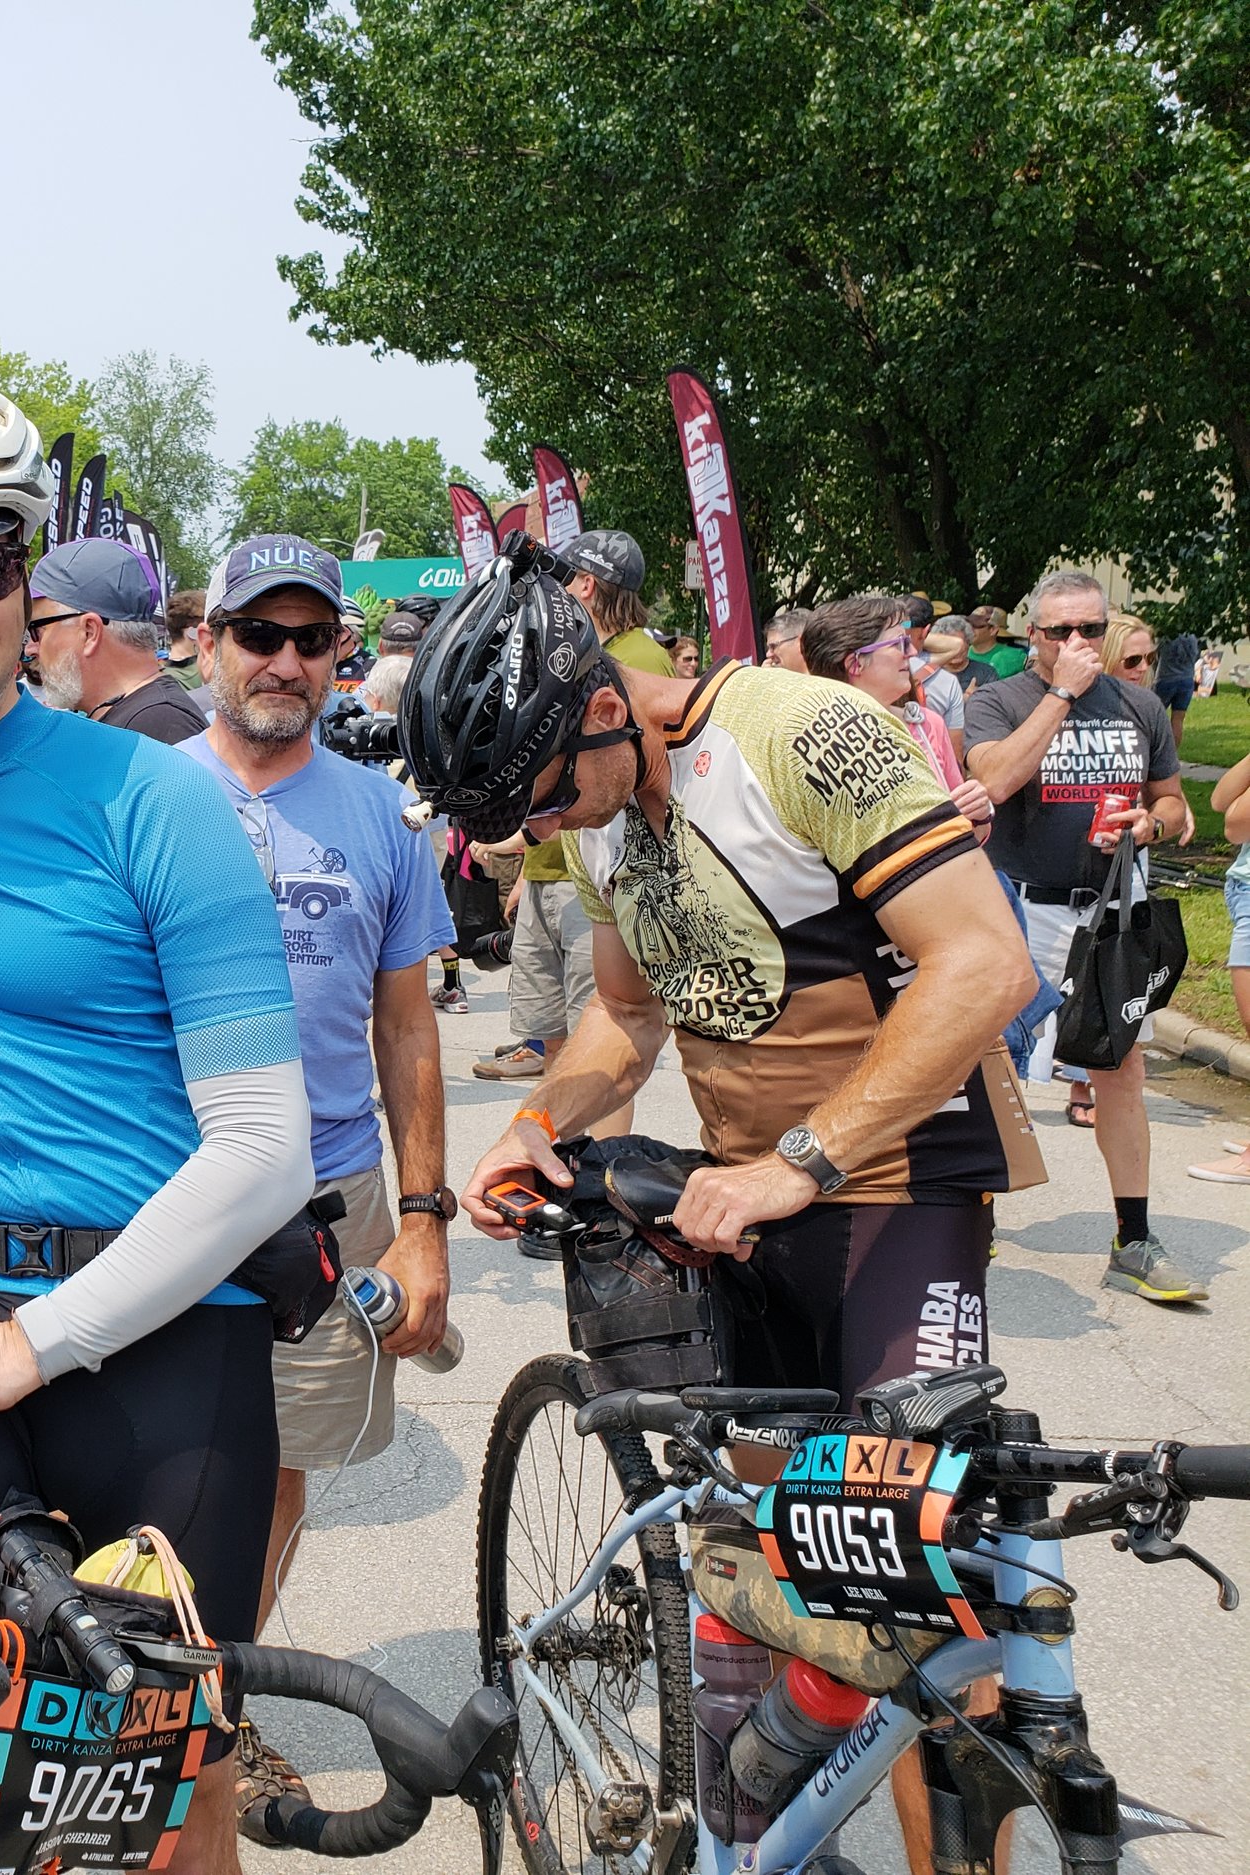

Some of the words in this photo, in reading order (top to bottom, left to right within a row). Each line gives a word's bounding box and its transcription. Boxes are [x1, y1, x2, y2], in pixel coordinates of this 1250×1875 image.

[76, 477, 93, 541] PEED
[251, 547, 315, 571] NUE
[551, 593, 565, 639] LIGHT
[508, 632, 524, 685] GIRO
[792, 695, 860, 767] PISGAH
[1040, 754, 1144, 771] MOUNTAIN
[1041, 771, 1075, 785] FILM
[1079, 770, 1144, 785] FESTIVAL
[853, 766, 913, 820] CHALLENGE
[1046, 788, 1101, 800] WORLD
[283, 929, 313, 942] DIRT
[283, 941, 317, 953] ROAD
[652, 951, 694, 983] PISGAH
[658, 957, 767, 998] ONSTER
[915, 1281, 960, 1369] HABA
[956, 1293, 982, 1366] CLES
[712, 1489, 729, 1502] ELLA
[785, 1484, 809, 1495] DIRTY
[811, 1484, 842, 1496] KANZA
[844, 1486, 874, 1498] EXTRA
[876, 1488, 911, 1500] LARGE
[1088, 1485, 1114, 1503] XT
[790, 1503, 907, 1578] 9053
[843, 1585, 863, 1598] LEE
[860, 1586, 888, 1601] NEAL
[183, 1651, 217, 1662] GARMIN
[31, 1737, 70, 1751] DIRTY
[72, 1744, 113, 1756] KANZA
[115, 1740, 144, 1755] EXTRA
[146, 1733, 178, 1750] LARGE
[814, 1703, 890, 1797] CHUMBA
[20, 1756, 162, 1831] 9065
[35, 1834, 63, 1855] JASON
[63, 1832, 112, 1846] SHEARER
